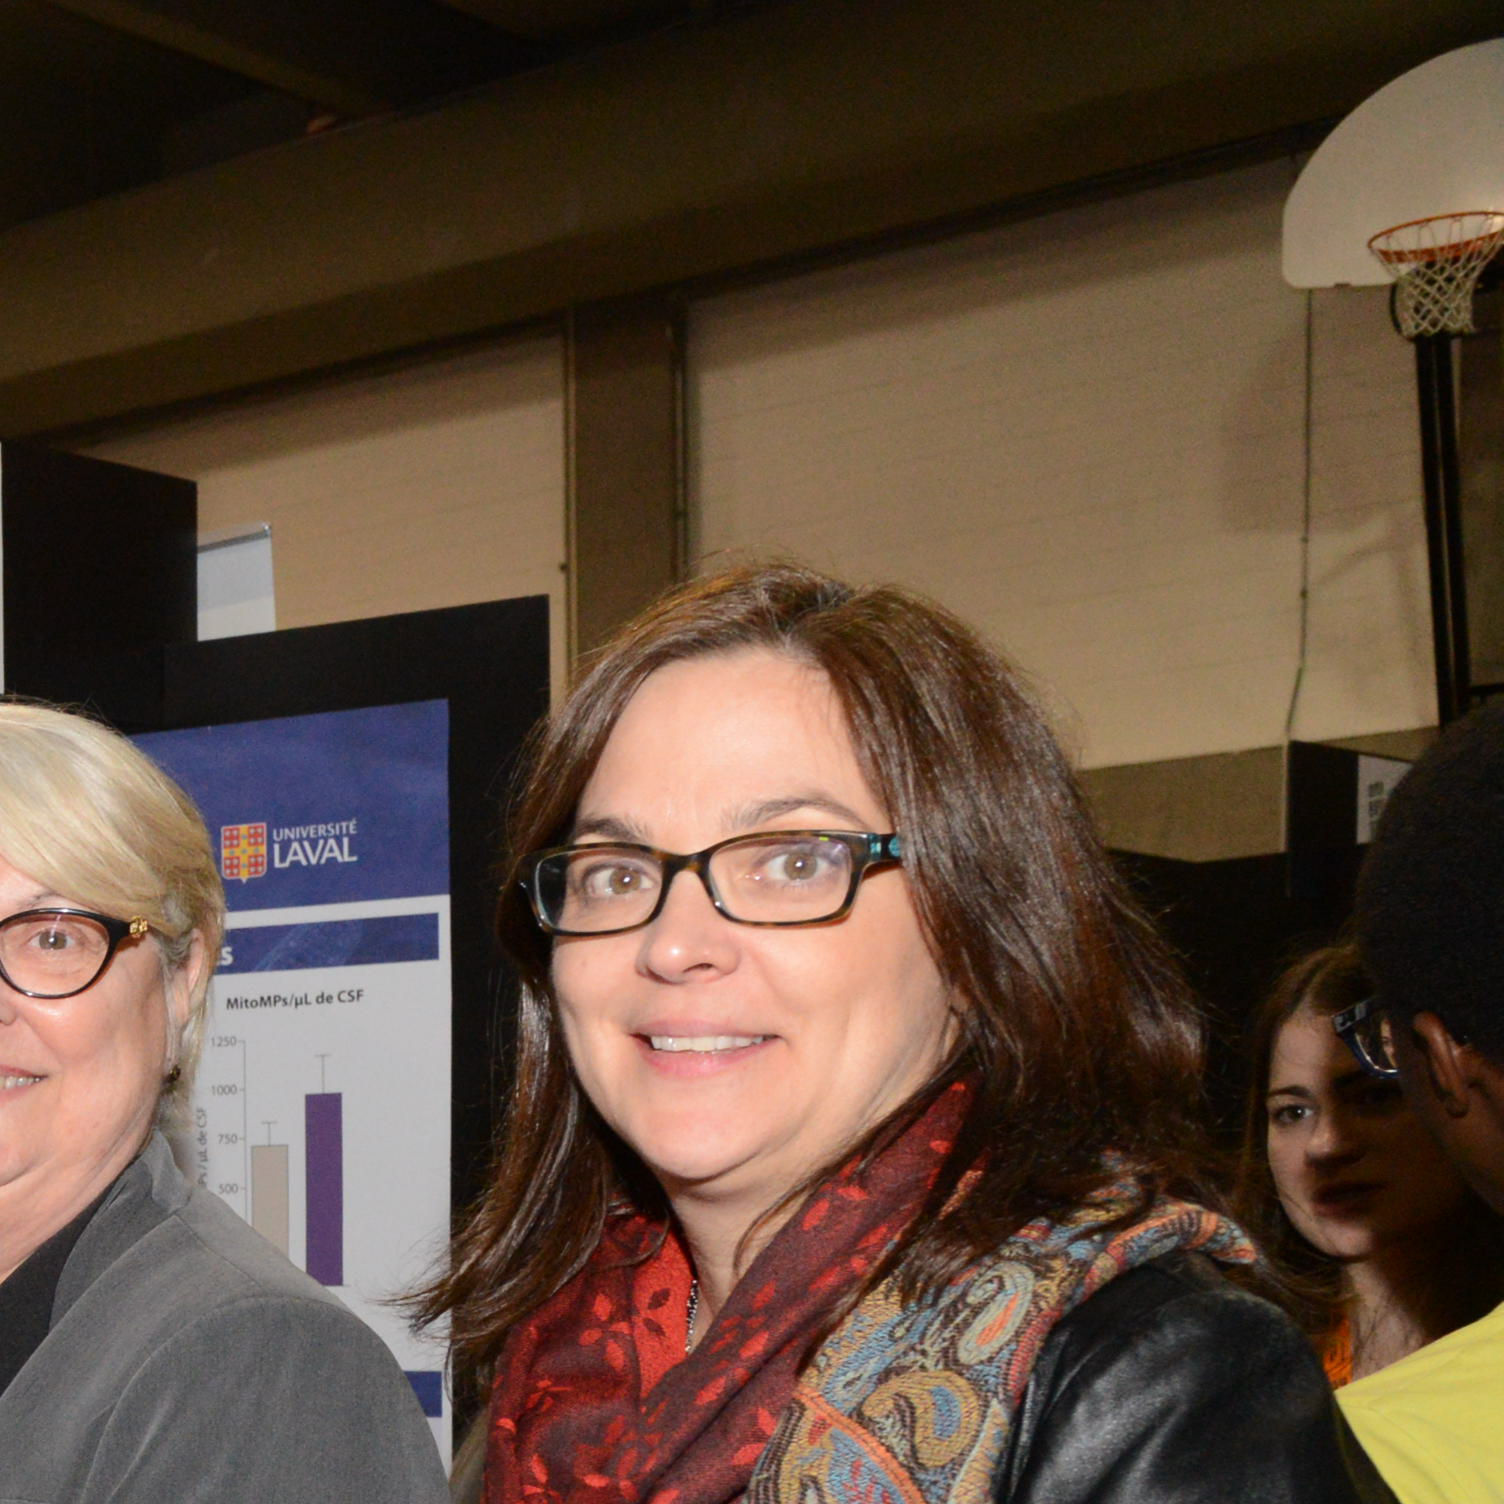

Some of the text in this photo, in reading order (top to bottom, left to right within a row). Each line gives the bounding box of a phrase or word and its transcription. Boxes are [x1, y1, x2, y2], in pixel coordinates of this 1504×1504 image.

[272, 819, 358, 842] UNIVERSITÉ
[272, 836, 358, 869] LAVAL
[315, 993, 335, 1006] de
[337, 989, 365, 1004] CSF
[210, 1036, 238, 1048] 1250
[211, 1084, 238, 1096] 1000
[218, 1133, 238, 1145] 750
[219, 1184, 239, 1195] 500
